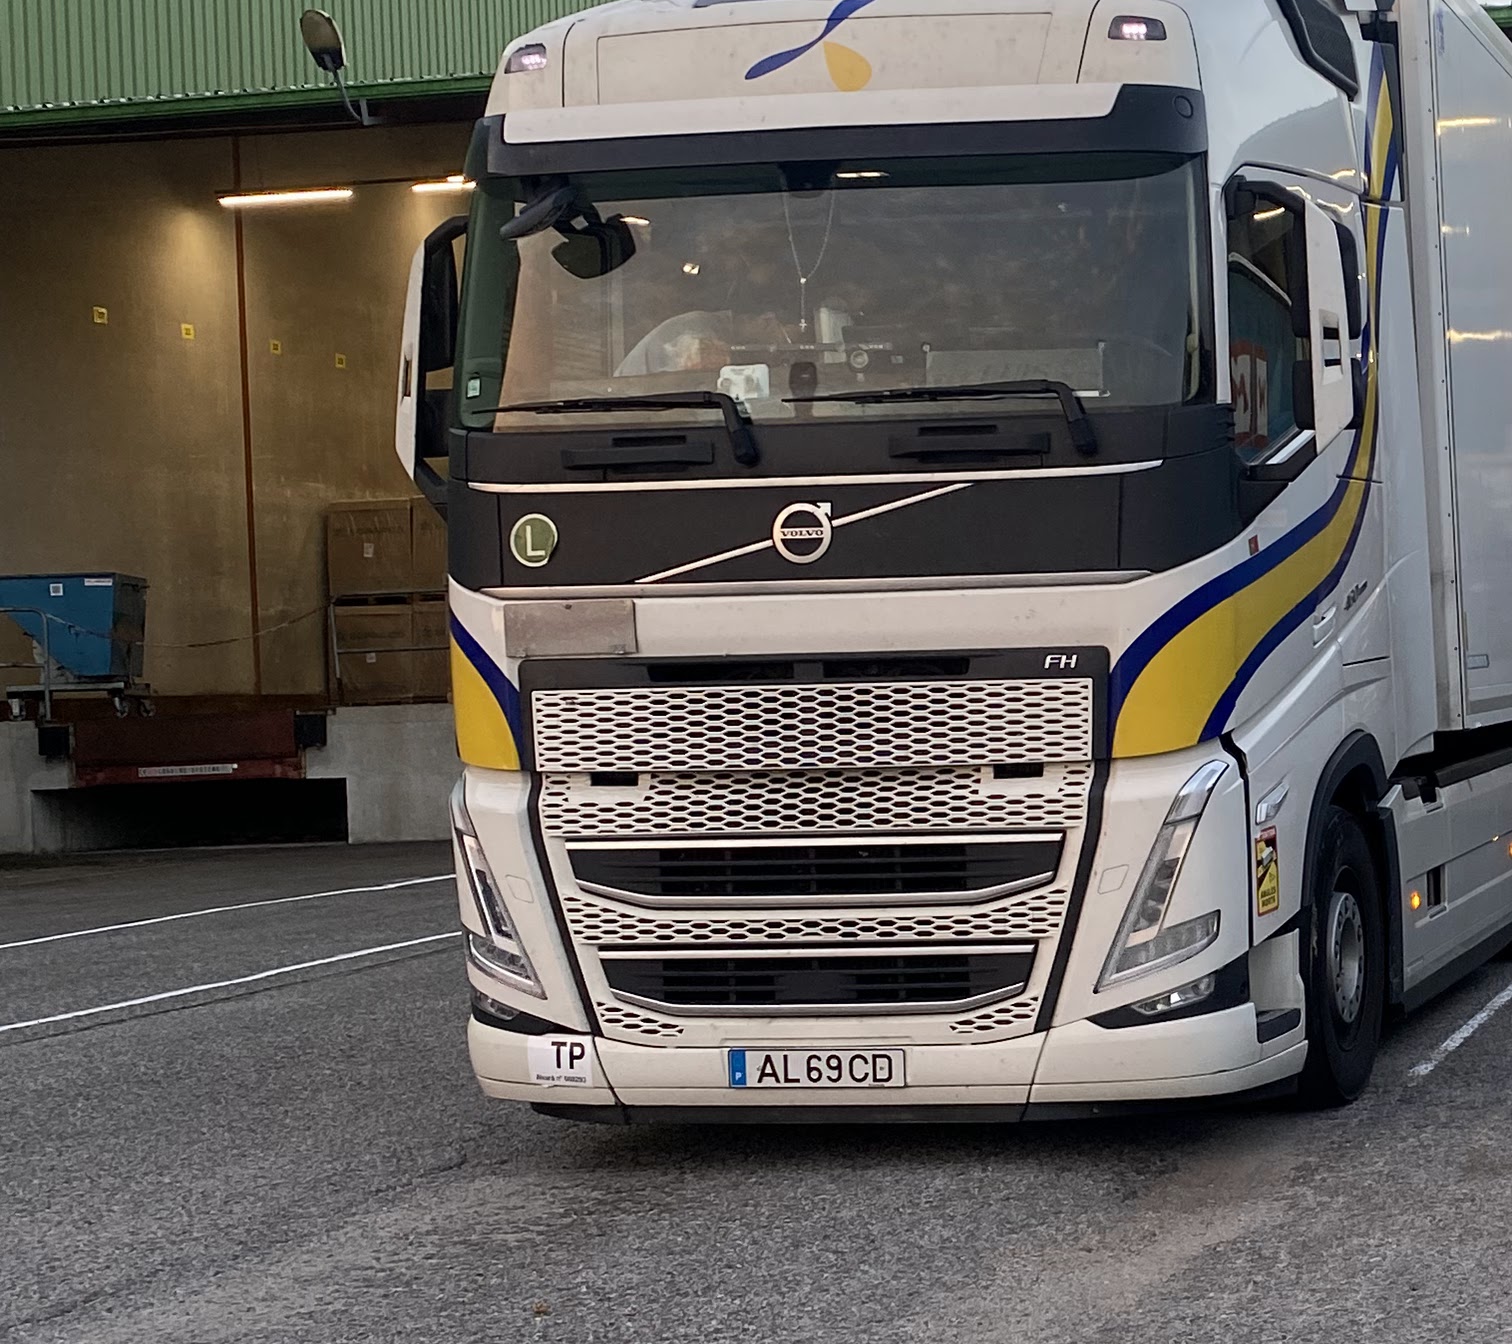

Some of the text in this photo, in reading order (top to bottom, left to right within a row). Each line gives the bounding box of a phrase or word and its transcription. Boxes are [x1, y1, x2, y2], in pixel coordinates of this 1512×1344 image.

[525, 525, 546, 556] L
[780, 529, 824, 537] VOLVO
[1043, 654, 1078, 669] FH
[551, 1041, 585, 1069] TP
